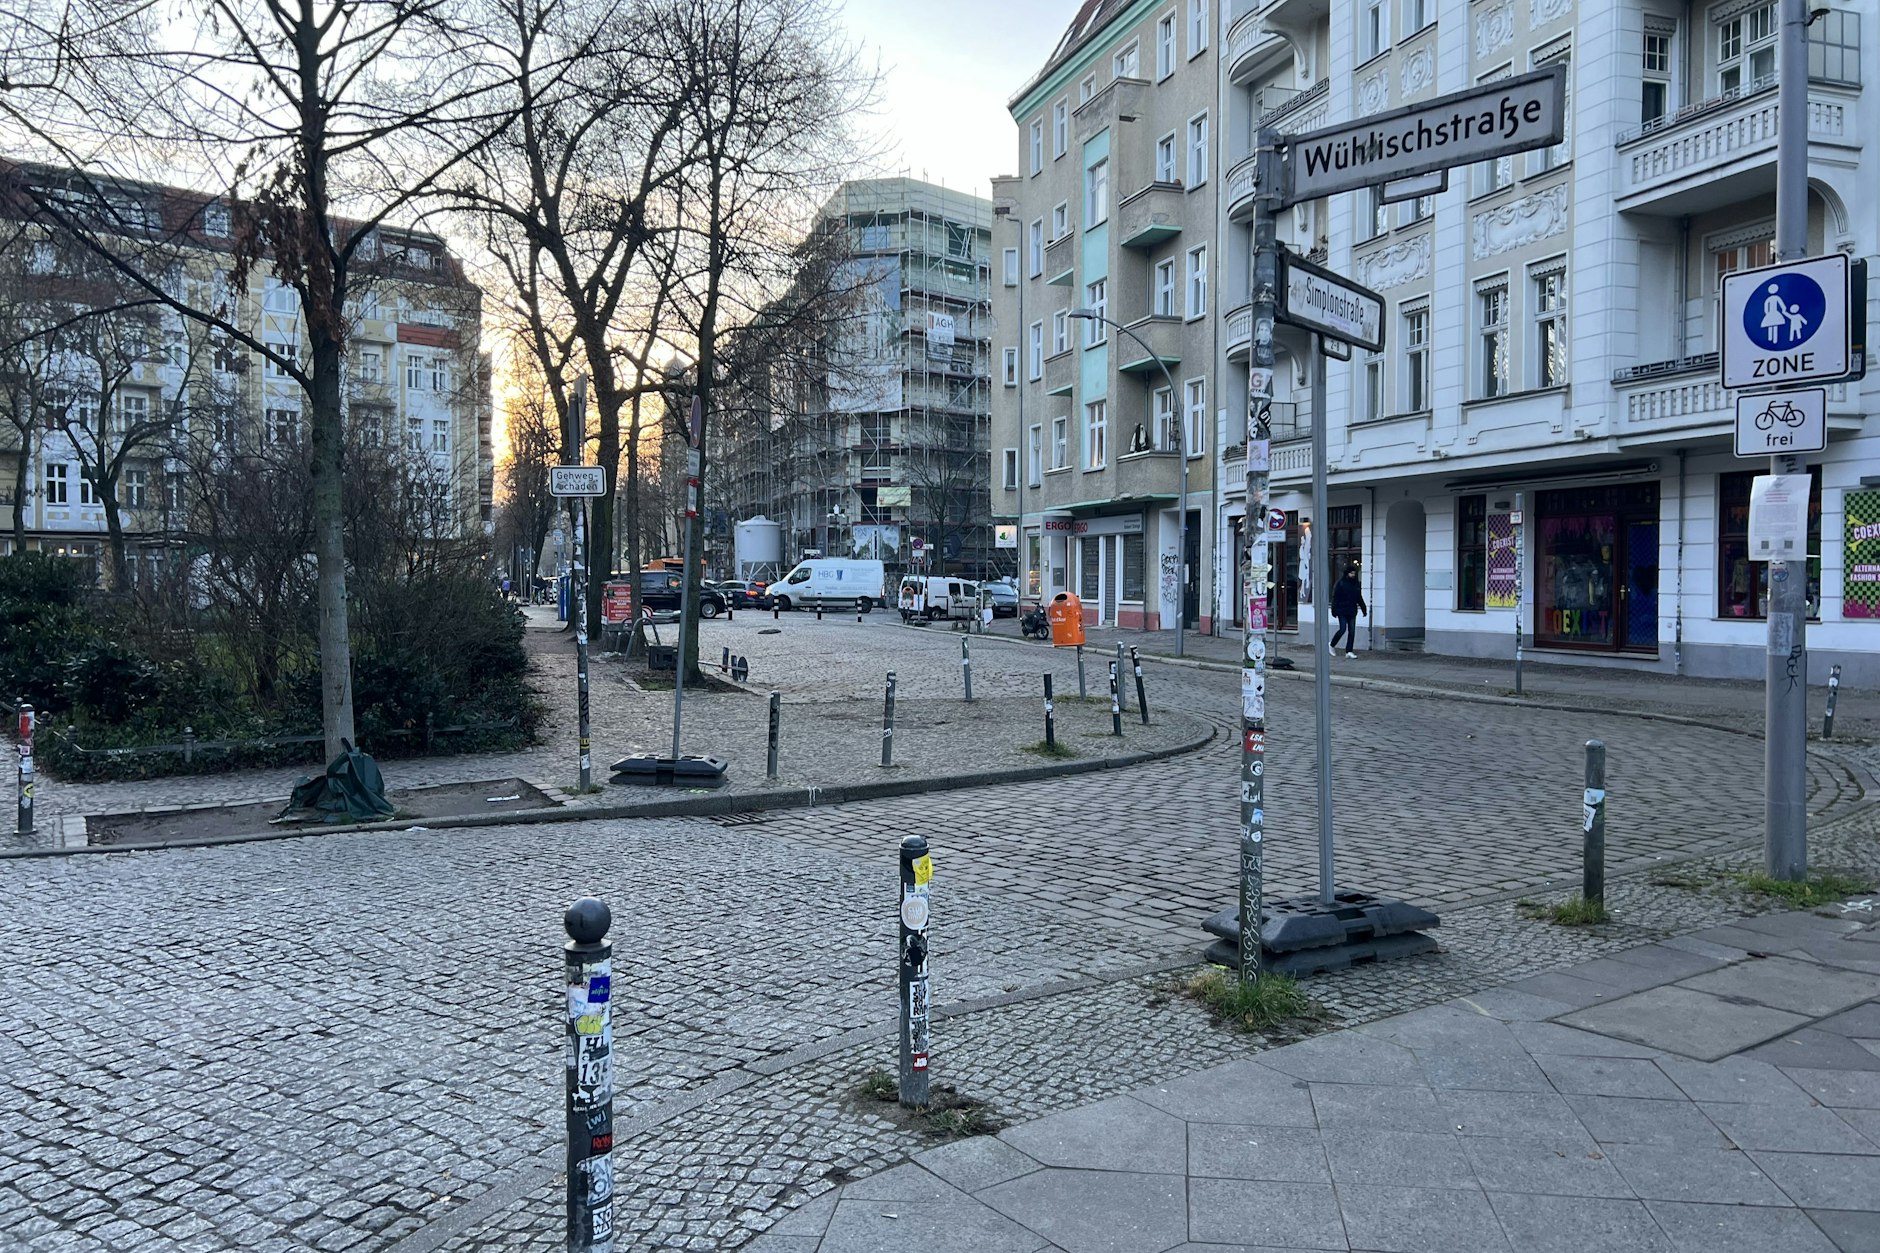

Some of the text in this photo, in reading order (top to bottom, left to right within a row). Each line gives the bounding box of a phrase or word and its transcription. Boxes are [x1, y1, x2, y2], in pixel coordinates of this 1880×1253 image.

[1304, 96, 1541, 177] Wühlischstraße
[1306, 276, 1364, 325] Simplonstraße
[936, 317, 954, 329] AGH
[1752, 352, 1814, 378] ZONE
[1766, 432, 1793, 446] frei
[556, 471, 598, 482] Gehweg-
[1045, 521, 1072, 530] ERGO
[1074, 522, 1088, 533] ERGO
[1493, 536, 1514, 550] COEXIST
[817, 570, 834, 578] HBG
[1850, 573, 1876, 582] FASHION
[593, 1210, 612, 1226] NO
